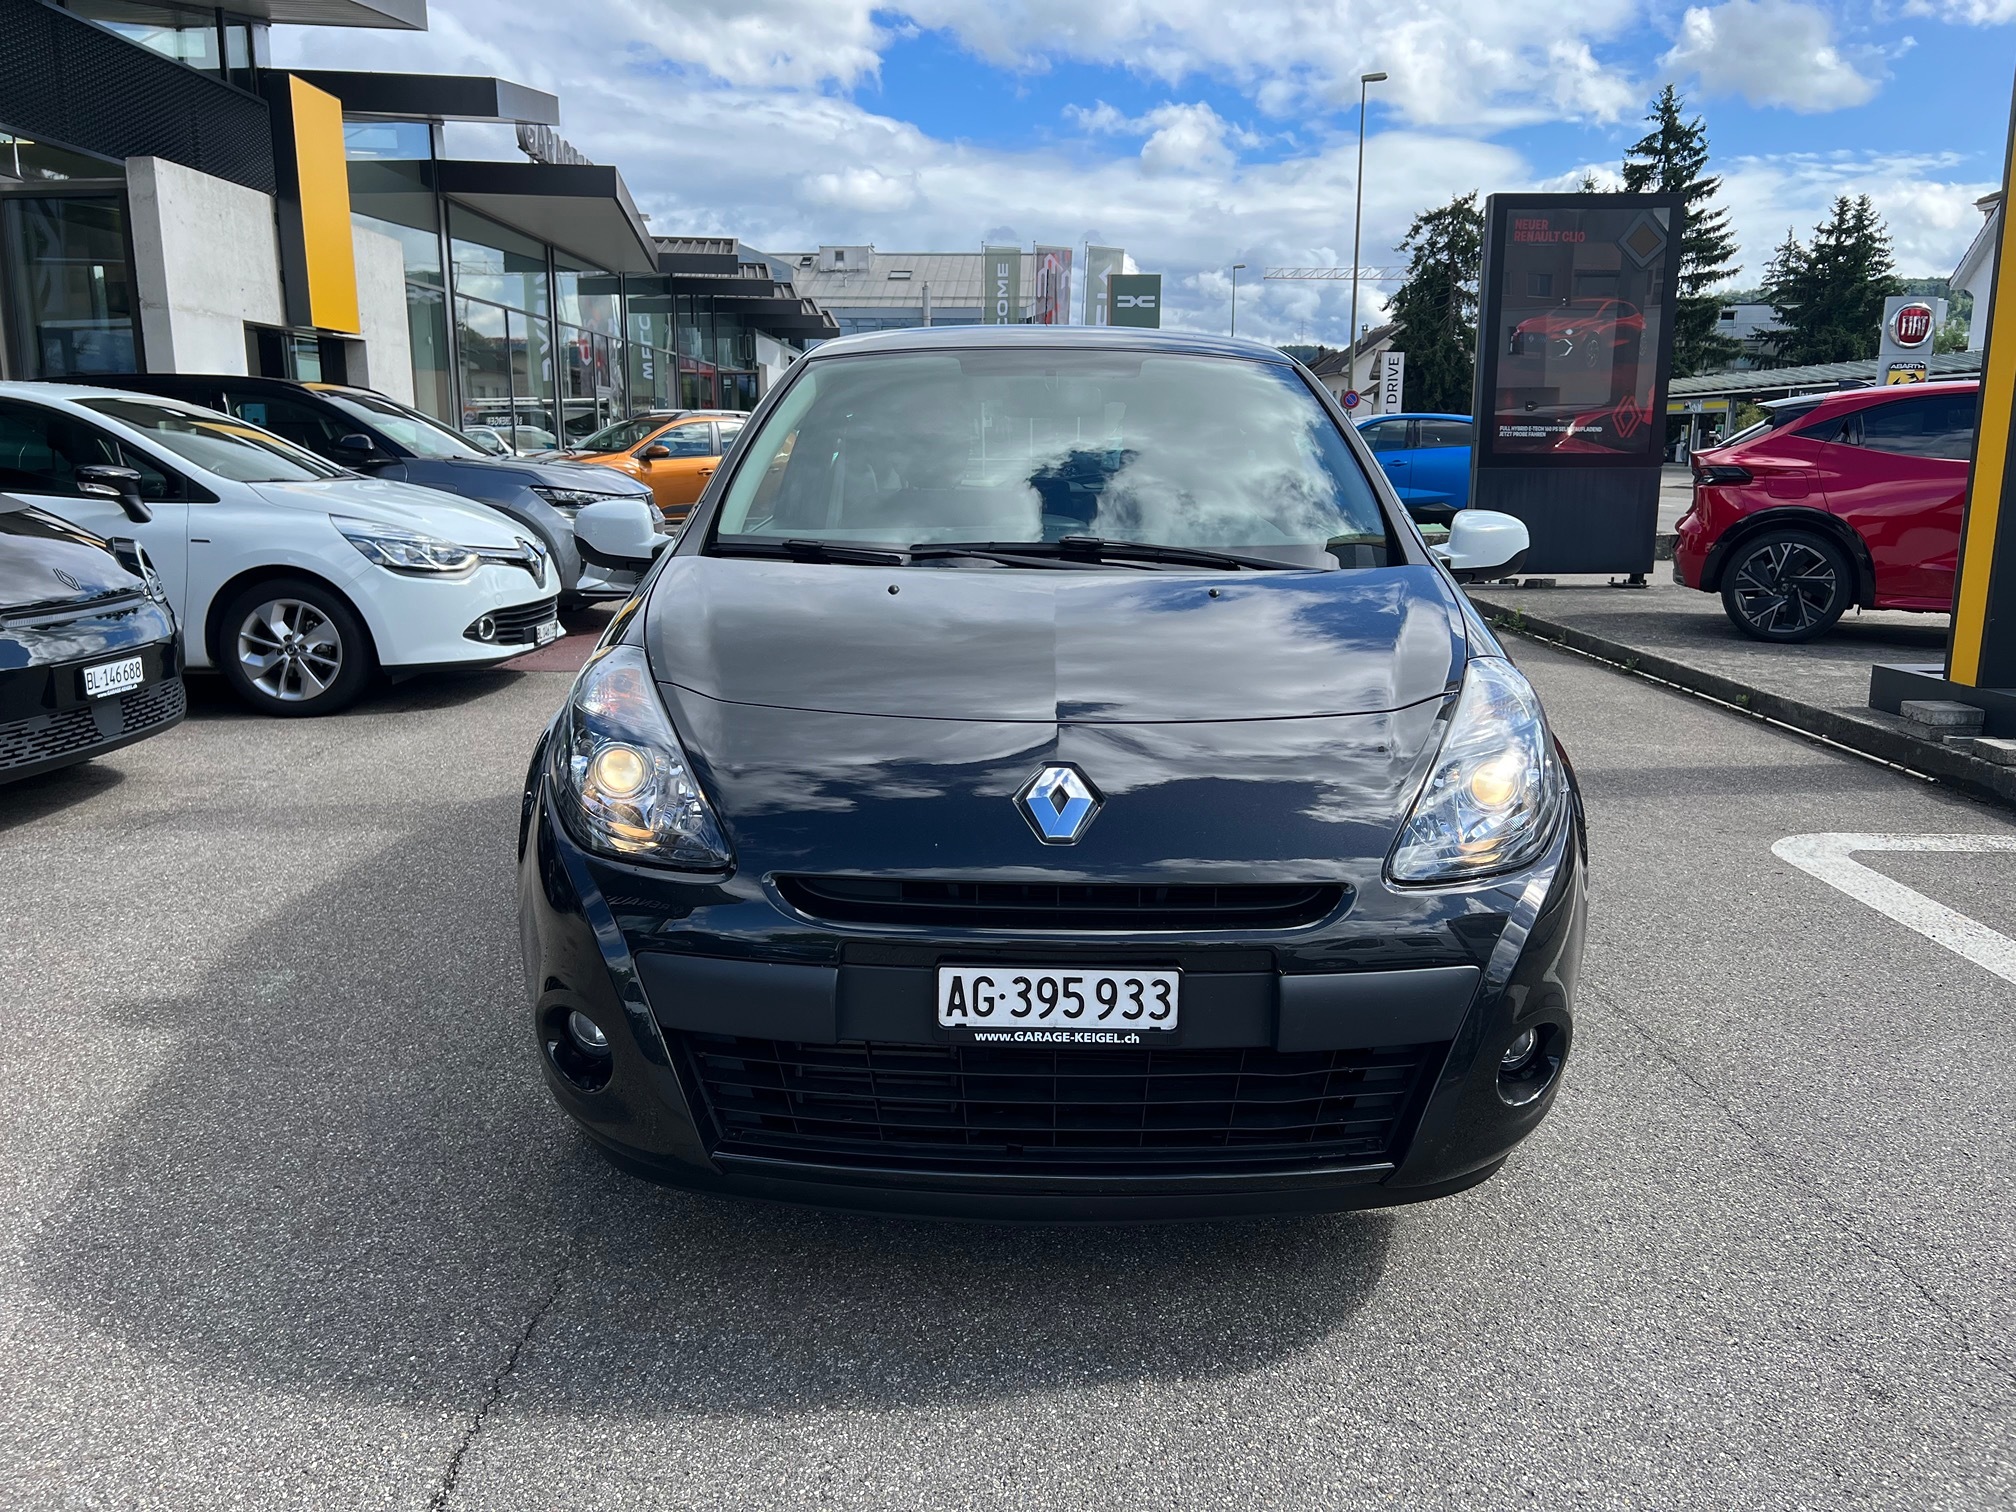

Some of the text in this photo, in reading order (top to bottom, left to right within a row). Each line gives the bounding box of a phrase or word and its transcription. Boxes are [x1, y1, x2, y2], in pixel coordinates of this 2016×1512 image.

[1515, 219, 1549, 230] NEUER
[1514, 231, 1586, 242] RENAULT CLIO
[1901, 315, 1929, 336] FIAT
[1386, 357, 1400, 405] DRIVE
[974, 1031, 1140, 1044] www.GARAGE-KEIGEL.ch
